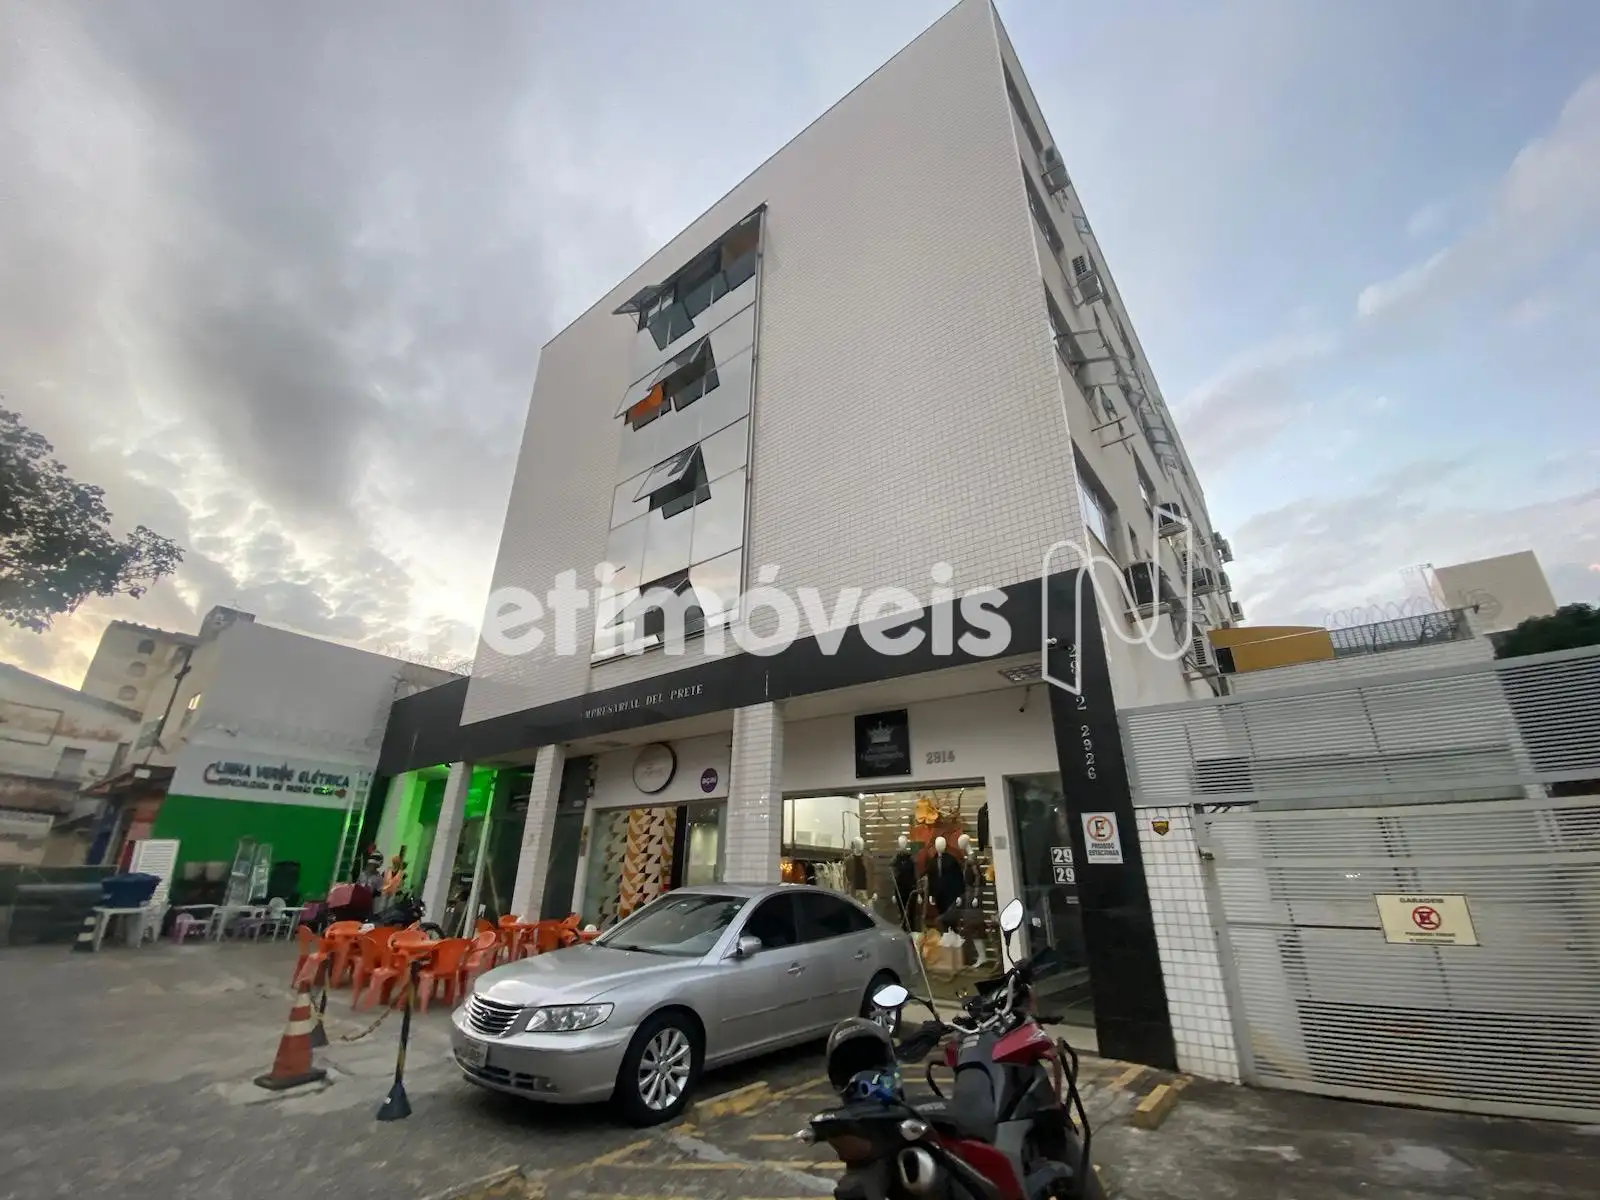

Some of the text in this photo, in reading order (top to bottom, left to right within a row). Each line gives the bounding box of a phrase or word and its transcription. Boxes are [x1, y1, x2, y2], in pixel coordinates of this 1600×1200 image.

[645, 691, 664, 706] DEL
[670, 684, 703, 701] PRETE
[1080, 724, 1097, 780] 2926
